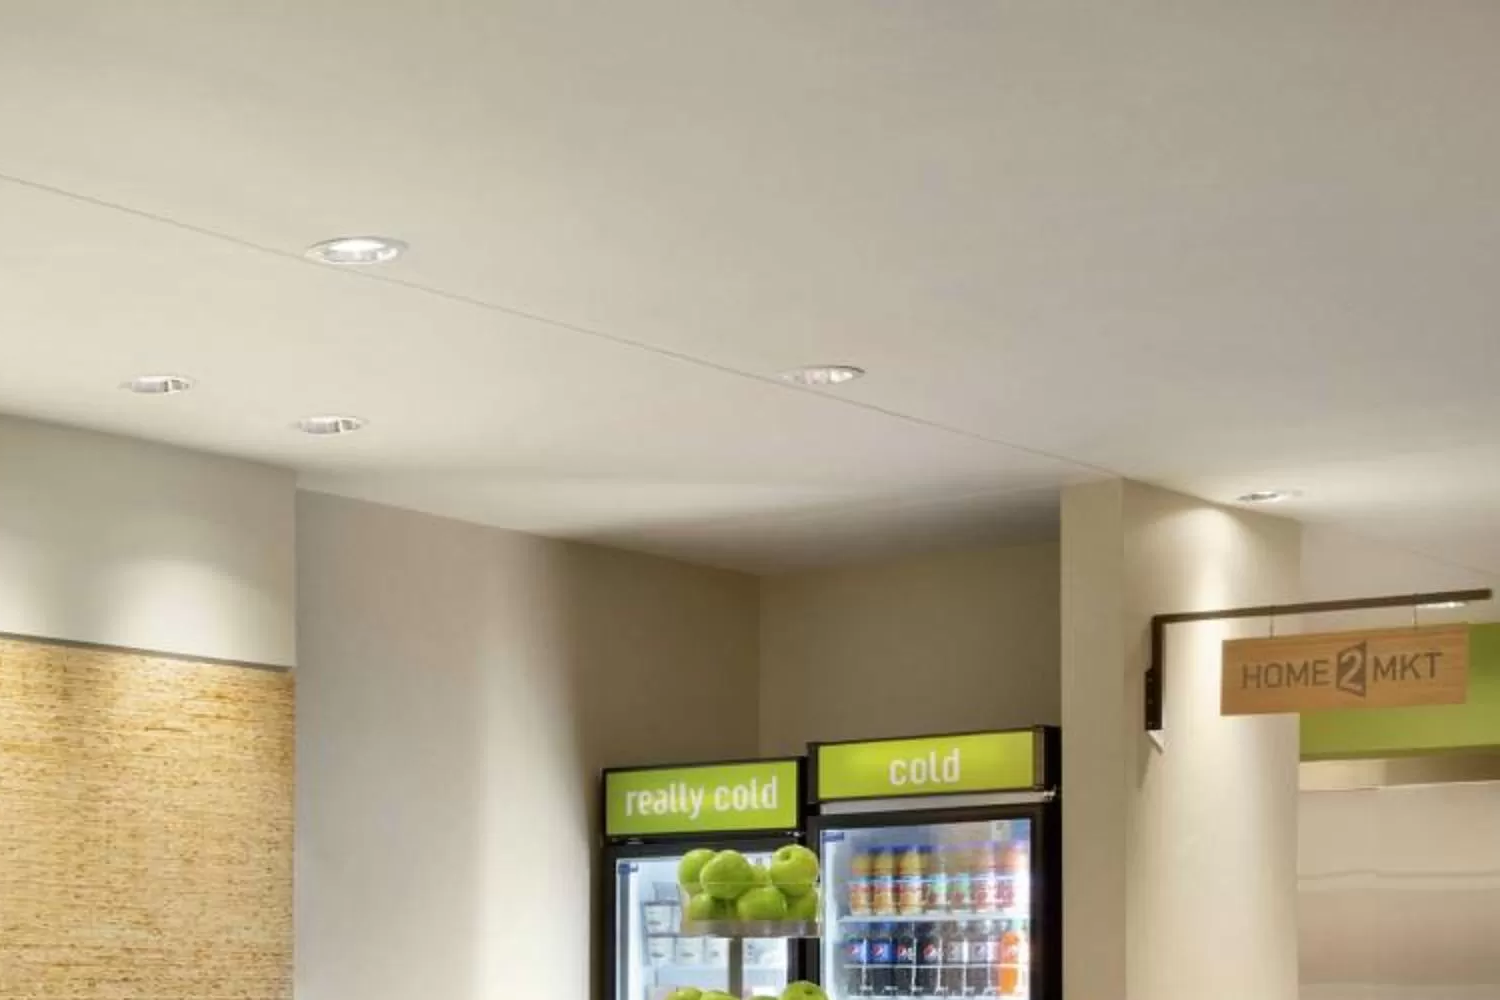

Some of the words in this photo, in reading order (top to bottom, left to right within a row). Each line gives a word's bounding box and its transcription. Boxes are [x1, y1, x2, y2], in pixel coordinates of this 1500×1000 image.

[889, 748, 960, 786] cold
[625, 781, 702, 820] really
[713, 776, 778, 812] cold
